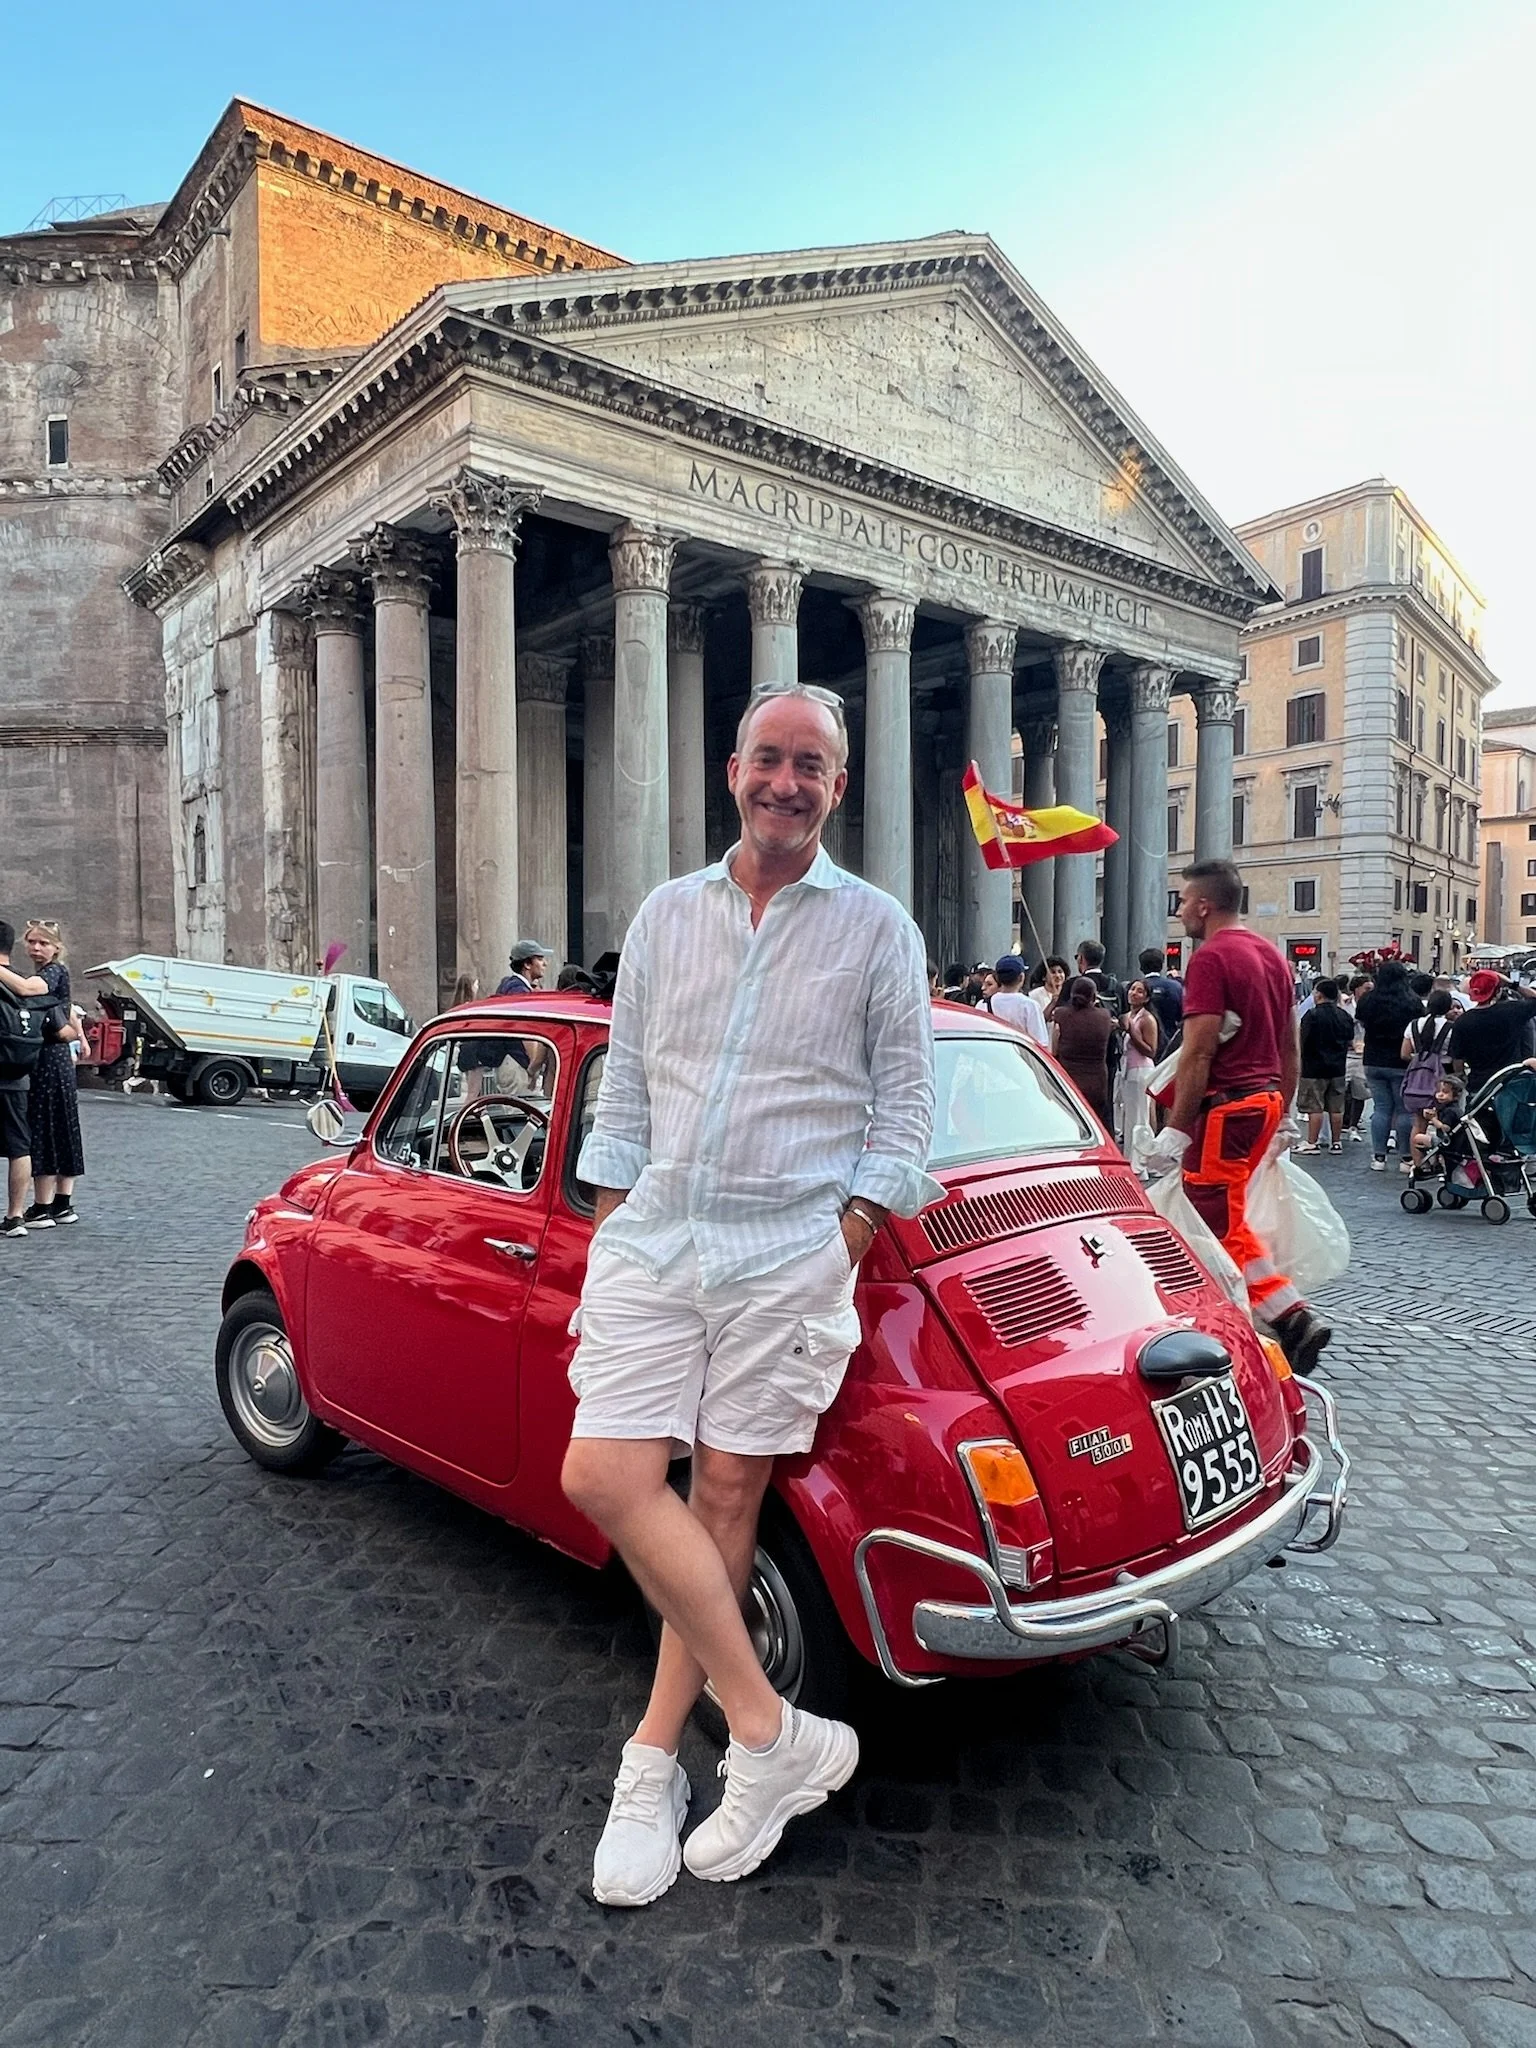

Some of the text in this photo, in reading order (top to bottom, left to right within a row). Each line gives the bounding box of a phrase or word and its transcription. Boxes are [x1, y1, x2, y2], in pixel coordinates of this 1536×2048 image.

[1092, 589, 1153, 629] FECIT
[1071, 1429, 1109, 1453] FIAT
[1094, 1436, 1131, 1461] 500L
[1182, 1430, 1258, 1517] 9555
